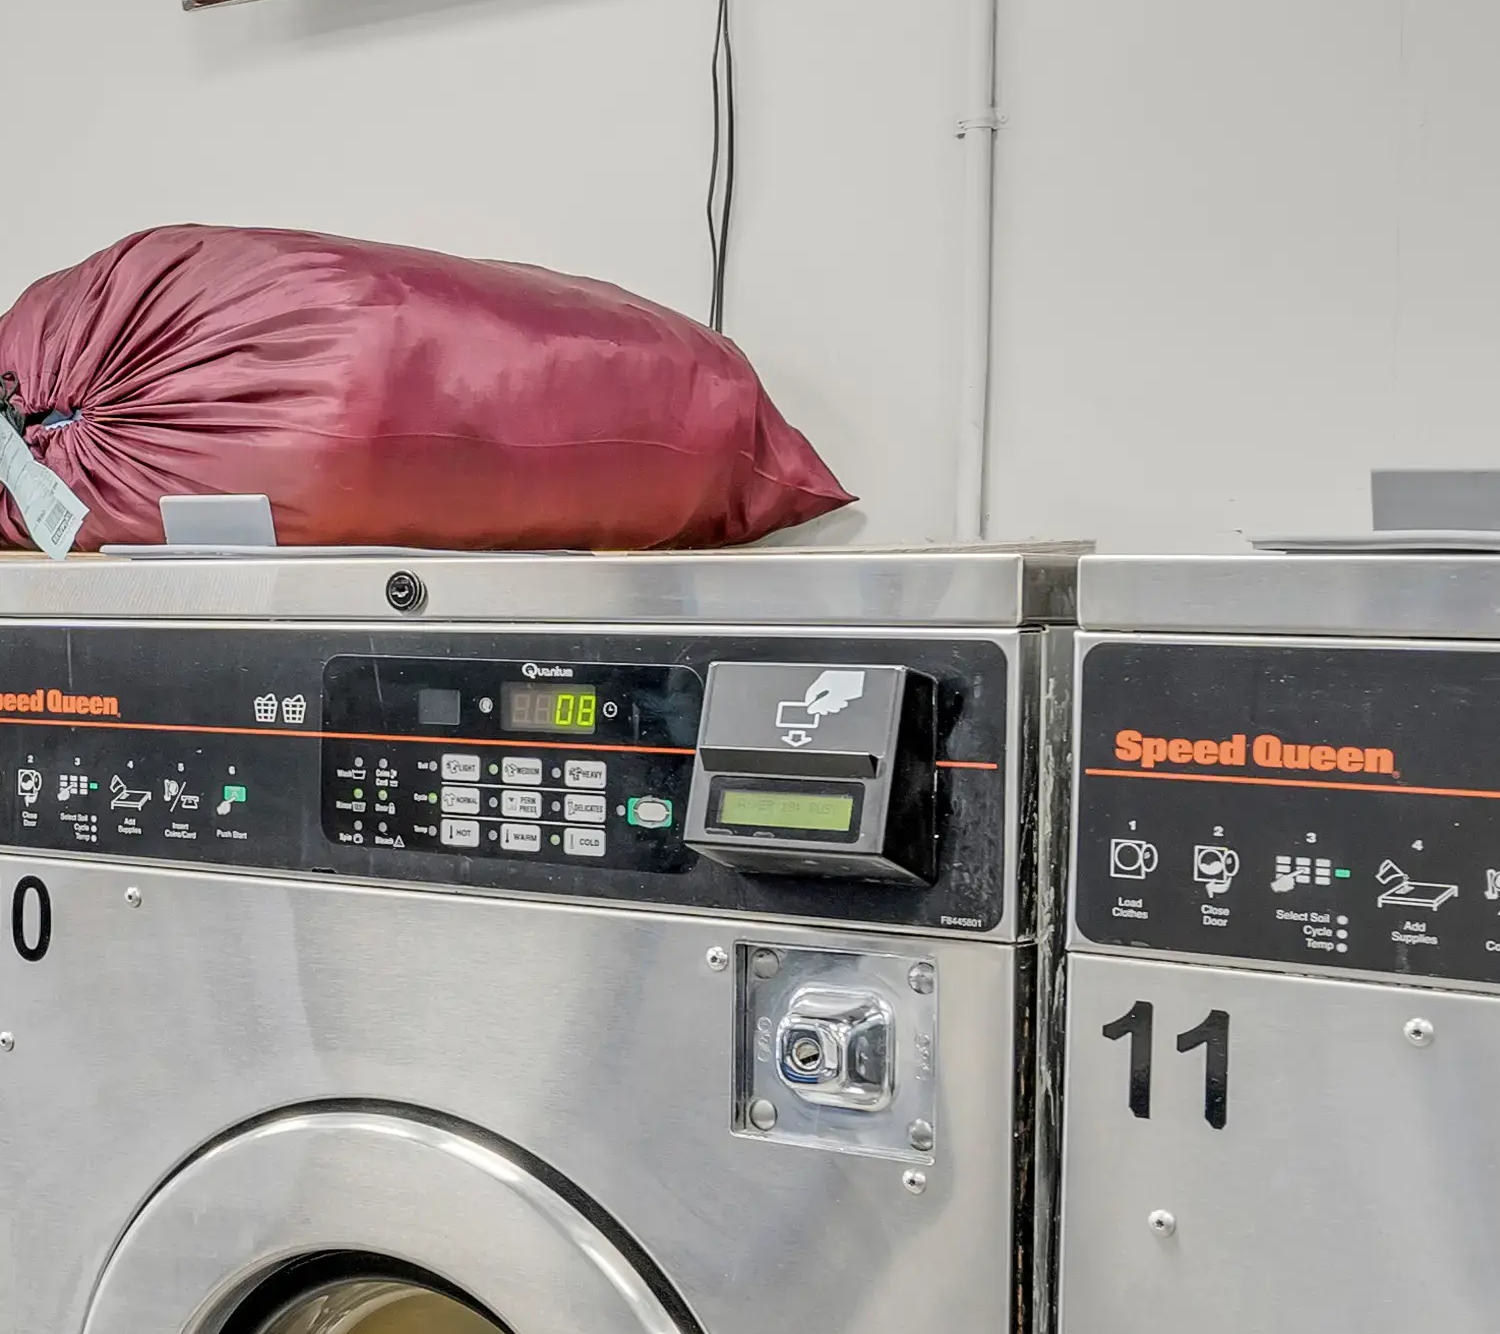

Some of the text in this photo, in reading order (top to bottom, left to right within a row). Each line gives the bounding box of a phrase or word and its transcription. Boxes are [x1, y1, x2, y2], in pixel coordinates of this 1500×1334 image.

[521, 663, 573, 679] Quantum
[47, 688, 118, 716] Queen
[1114, 729, 1394, 775] Speed Queen
[1128, 820, 1137, 831] 1
[1213, 825, 1224, 837] 2
[456, 829, 471, 837] HOT
[513, 833, 537, 842] WARM
[1306, 832, 1317, 843] 3
[579, 838, 600, 847] COLD
[1411, 840, 1423, 851] 4
[1118, 897, 1142, 908] Load
[1112, 907, 1149, 919] Clothes
[1201, 905, 1230, 916] Close
[1276, 910, 1330, 923] Select Soil
[1202, 915, 1228, 927] Door
[1403, 921, 1426, 933] Add
[1303, 925, 1333, 938] Cycle
[1391, 931, 1438, 945] Supplies
[1306, 939, 1334, 952] Temp
[1102, 1000, 1230, 1129] 11
